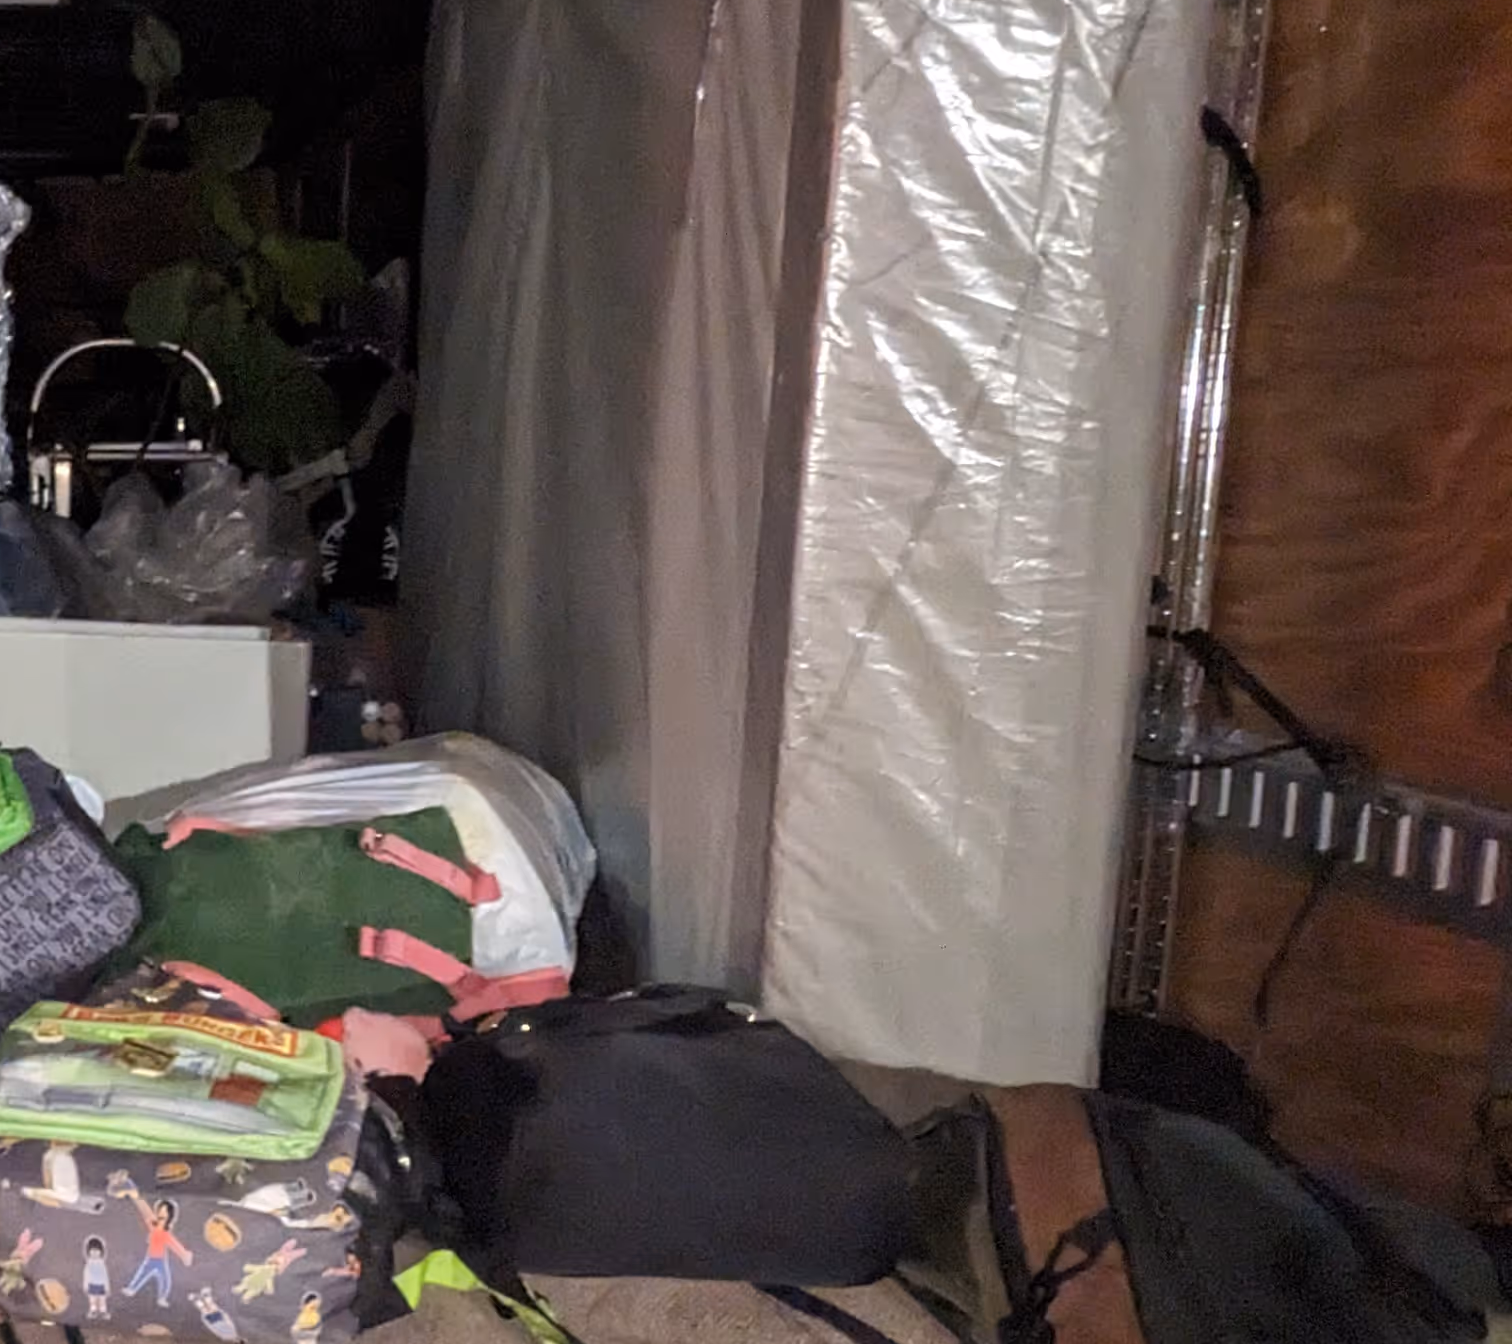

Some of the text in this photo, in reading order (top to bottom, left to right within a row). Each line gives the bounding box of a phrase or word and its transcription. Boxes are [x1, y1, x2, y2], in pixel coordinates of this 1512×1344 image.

[5, 854, 51, 899] FEAR
[45, 834, 78, 867] ON
[1, 923, 46, 965] SMELL
[38, 892, 80, 932] FEAR
